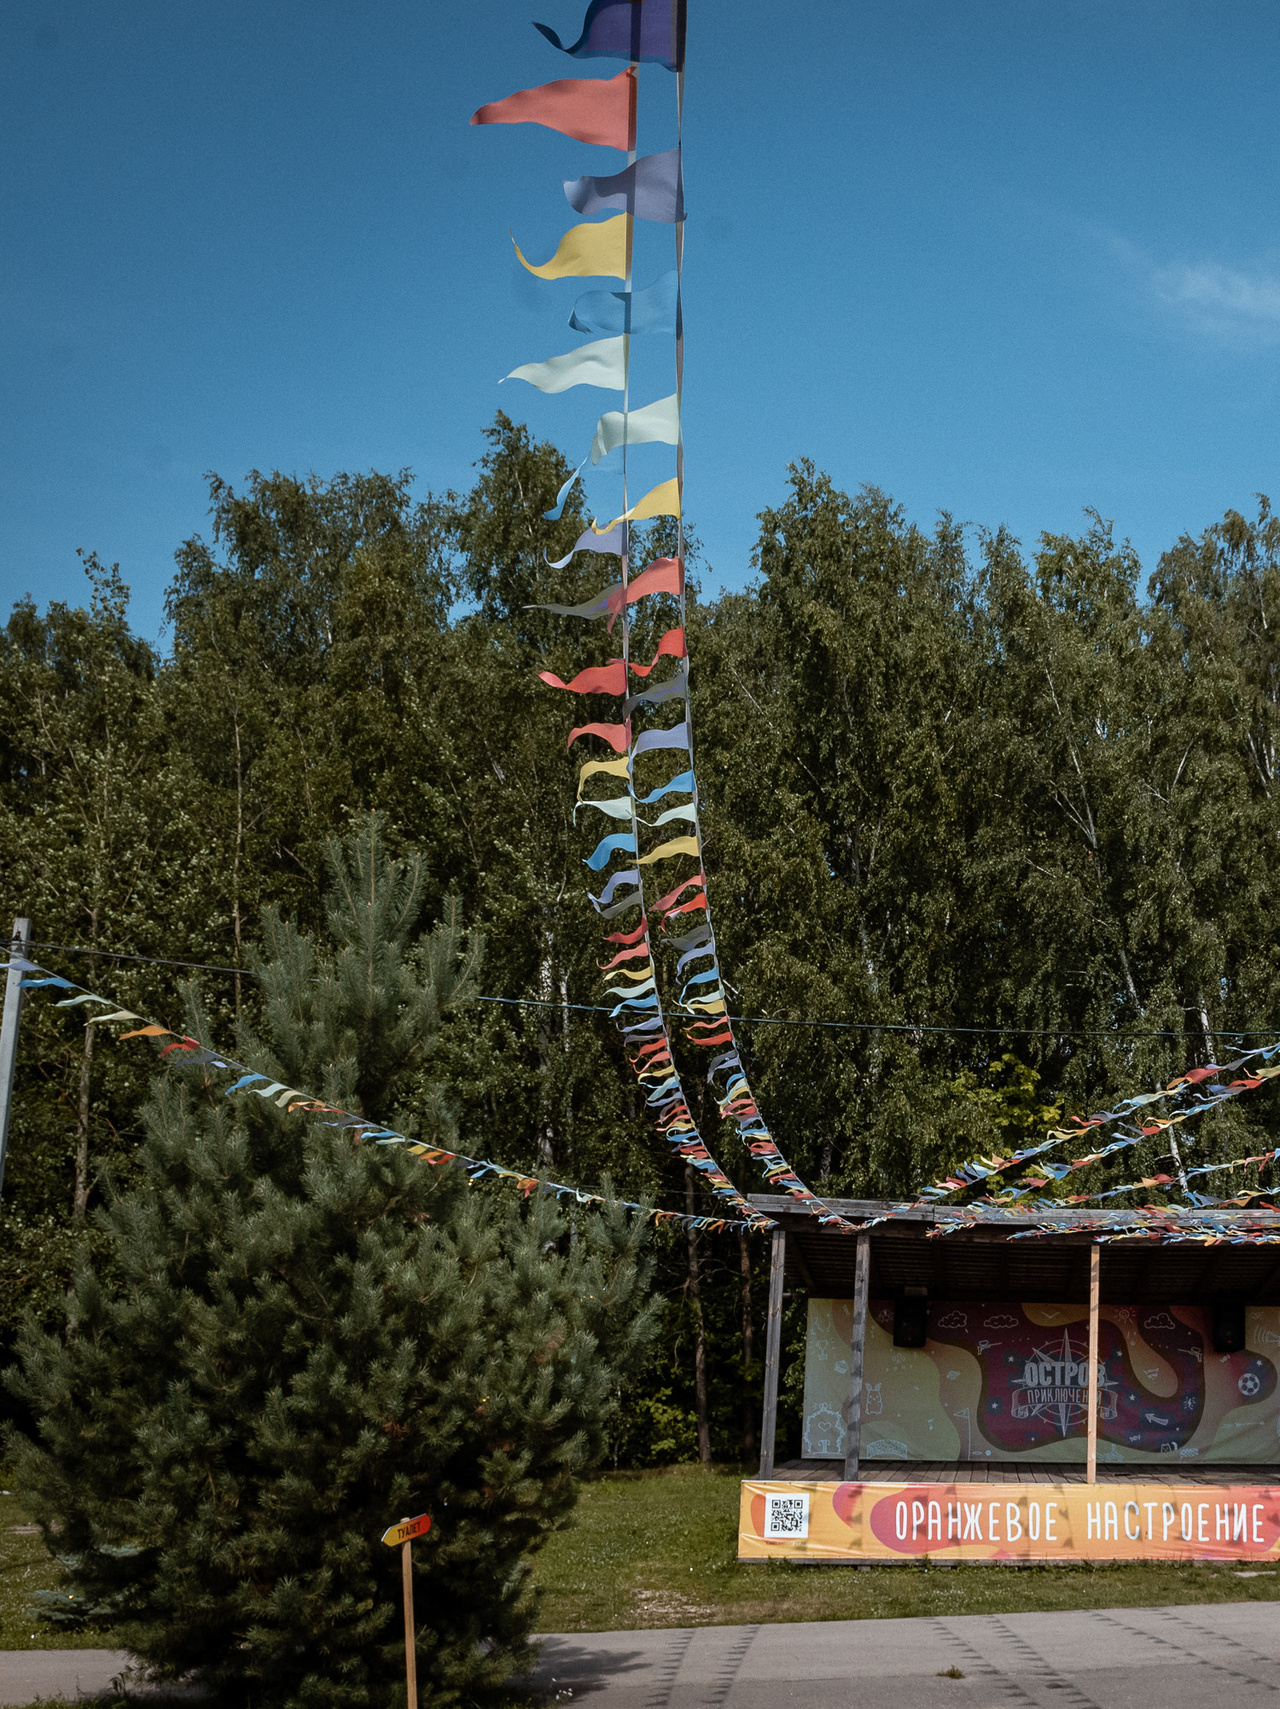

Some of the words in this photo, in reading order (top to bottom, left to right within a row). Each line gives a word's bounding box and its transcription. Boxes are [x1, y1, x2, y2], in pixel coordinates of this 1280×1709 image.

[1024, 1362, 1106, 1388] ОСТРОВ
[1027, 1388, 1102, 1405] ПРИКЛЮЧЕНЙ
[397, 1521, 421, 1539] ТУАЛЕТ
[896, 1501, 1057, 1542] ОРАНЖЕВОЕ
[1087, 1501, 1264, 1542] НАСТРОЕНИЕ
